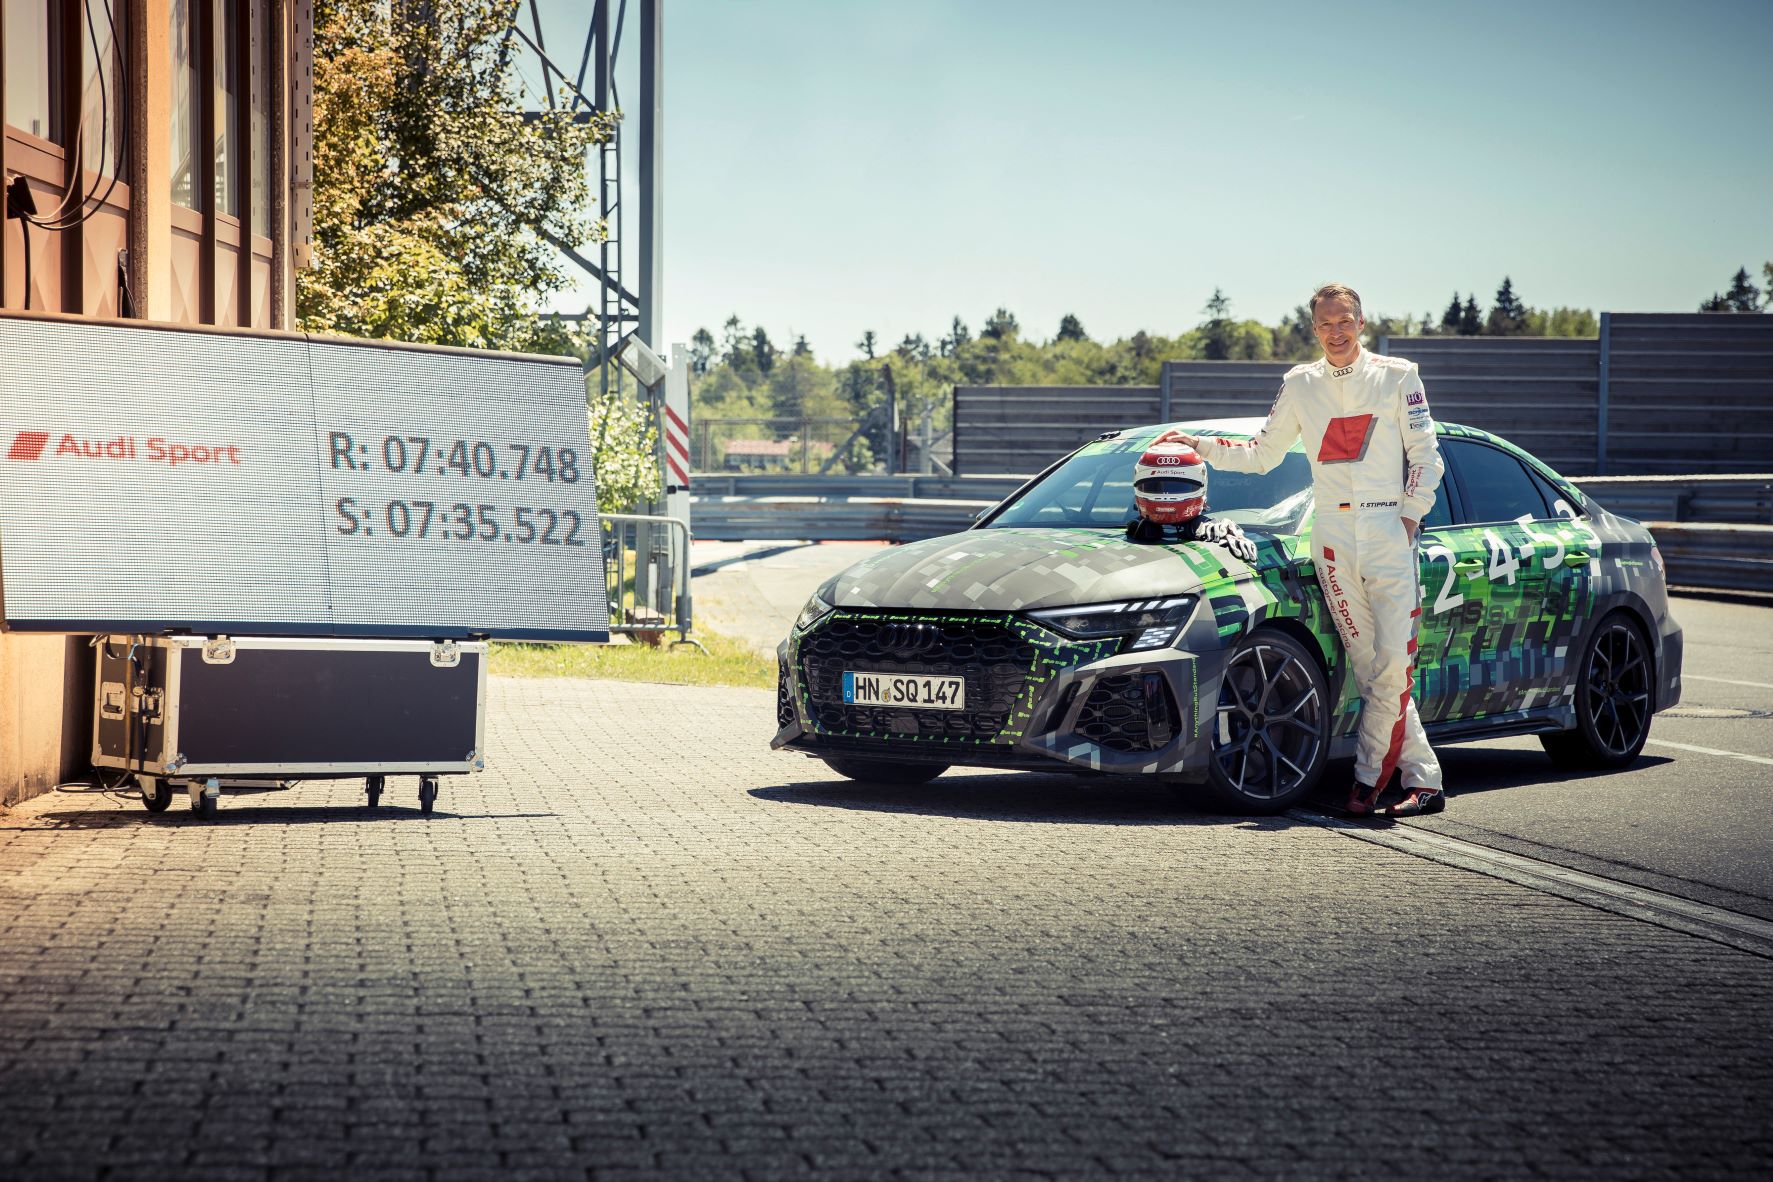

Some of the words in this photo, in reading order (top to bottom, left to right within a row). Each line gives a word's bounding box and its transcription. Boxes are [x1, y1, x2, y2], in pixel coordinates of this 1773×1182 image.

[56, 433, 136, 459] Audi
[147, 437, 241, 466] Sport
[328, 431, 369, 470] R:
[382, 435, 580, 484] 07:40.748
[336, 497, 372, 536] S:
[386, 500, 585, 546] 07:35.522
[1318, 567, 1338, 616] customer
[1335, 618, 1352, 648] racing
[1326, 564, 1344, 597] Audi
[1338, 599, 1360, 639] Sport
[846, 690, 851, 698] D
[855, 676, 880, 701] HN
[893, 679, 918, 703] SQ
[923, 680, 960, 705] 147
